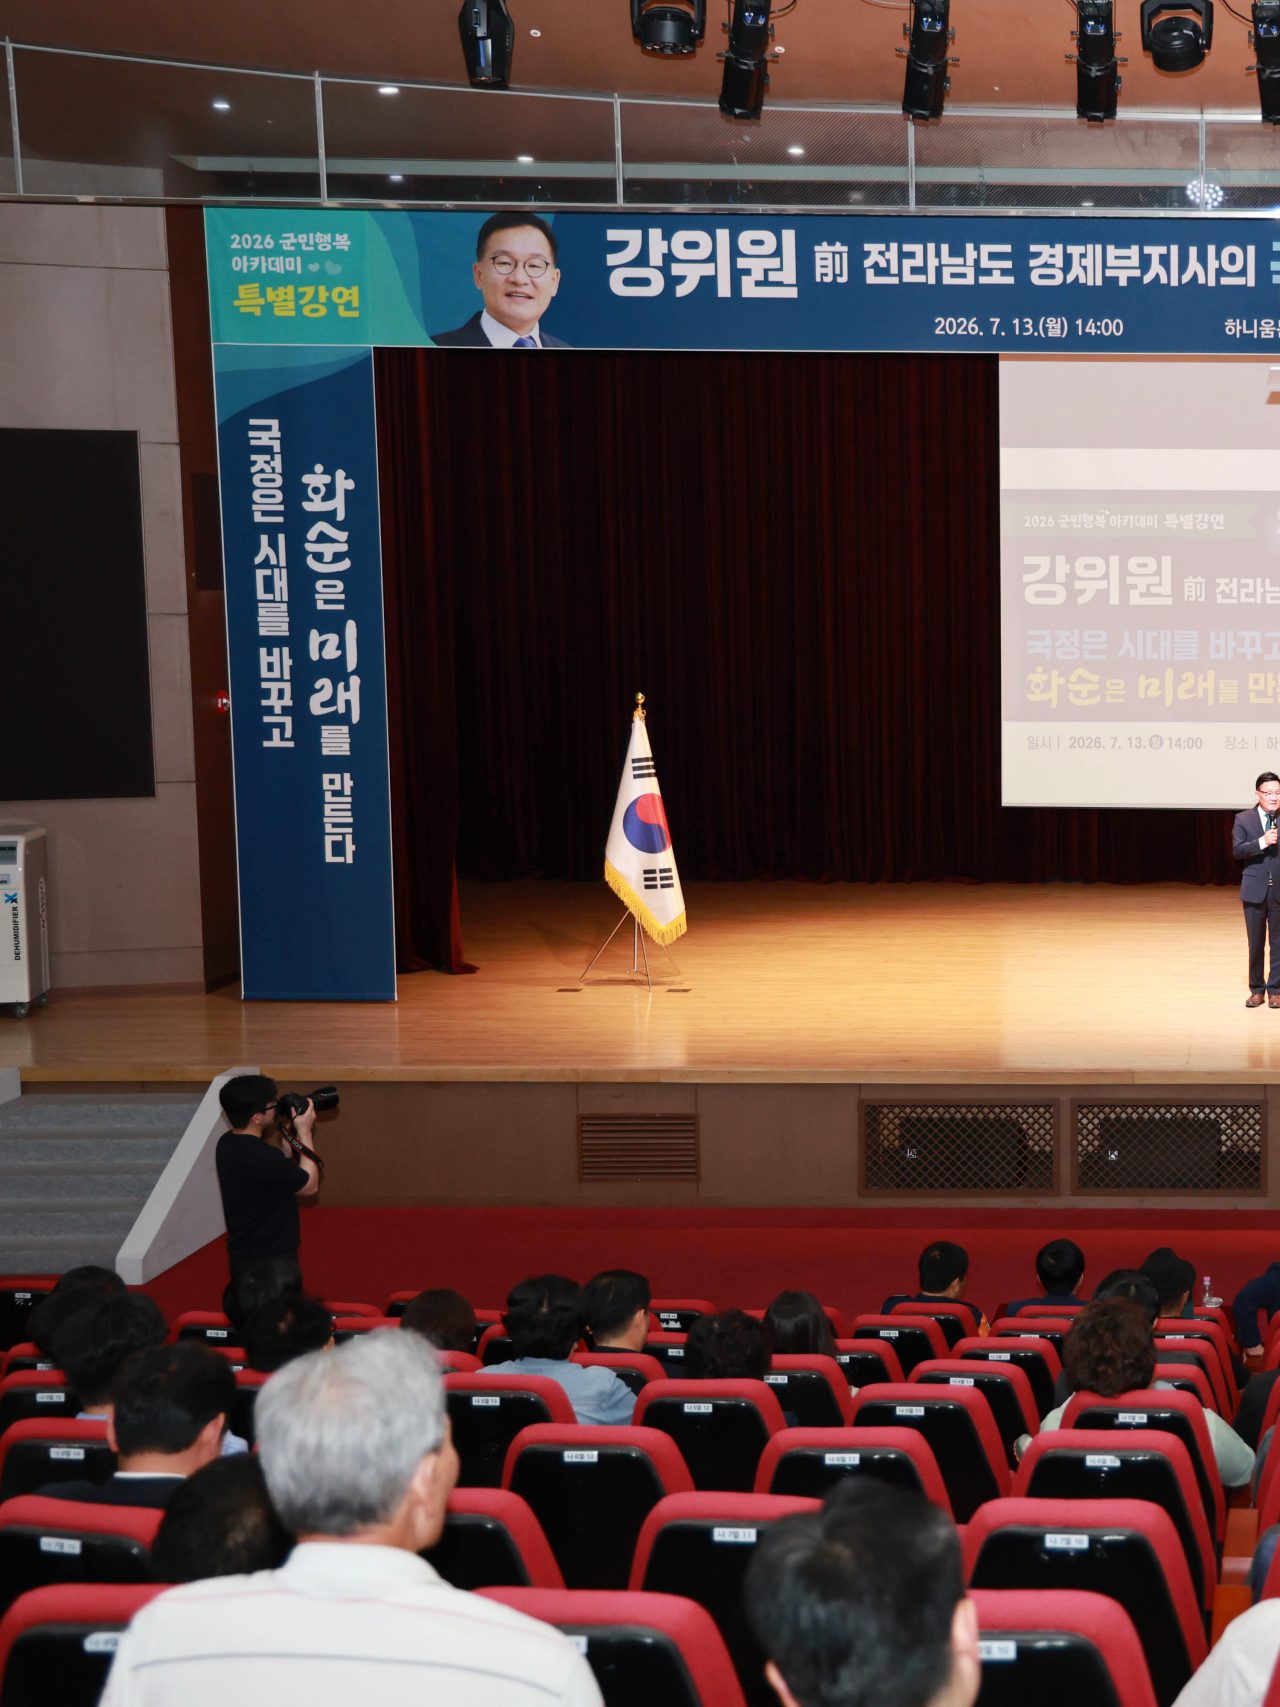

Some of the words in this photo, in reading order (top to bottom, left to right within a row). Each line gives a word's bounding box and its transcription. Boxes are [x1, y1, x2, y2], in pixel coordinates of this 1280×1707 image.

[230, 234, 275, 249] 2026
[279, 231, 351, 251] 군민행복
[231, 255, 302, 274] 아카데미
[606, 228, 798, 299] 강위원
[814, 241, 849, 283] 前
[863, 242, 1015, 286] 전라남도
[1028, 243, 1256, 288] 경제부지사의
[233, 282, 360, 318] 특별강연
[934, 317, 984, 336] 2026.
[989, 317, 1006, 336] 7.
[1012, 316, 1068, 338] 13.(월)
[1075, 318, 1124, 337] 14:00
[248, 418, 285, 523] 국정은
[301, 463, 355, 610] 화순은
[1024, 515, 1054, 528] 2026
[1057, 513, 1106, 529] 군민행복
[1109, 514, 1158, 529] 아카데미
[1163, 513, 1225, 530] 특별강연
[254, 533, 290, 636] 시대를
[1022, 555, 1173, 606] 강위원
[1183, 575, 1206, 603] 前
[1026, 629, 1108, 661] 국정은
[1118, 629, 1200, 661] 시대를
[259, 646, 295, 748] 바꾸고
[309, 619, 361, 756] 미래를
[1026, 665, 1126, 708] 화순은
[1138, 666, 1239, 707] 미래를
[1027, 735, 1052, 750] 일시
[1069, 736, 1106, 750] 2026.
[1110, 736, 1123, 750] 7.
[1168, 736, 1203, 750] 14:00
[1224, 736, 1249, 751] 장소
[322, 772, 356, 864] 만든다
